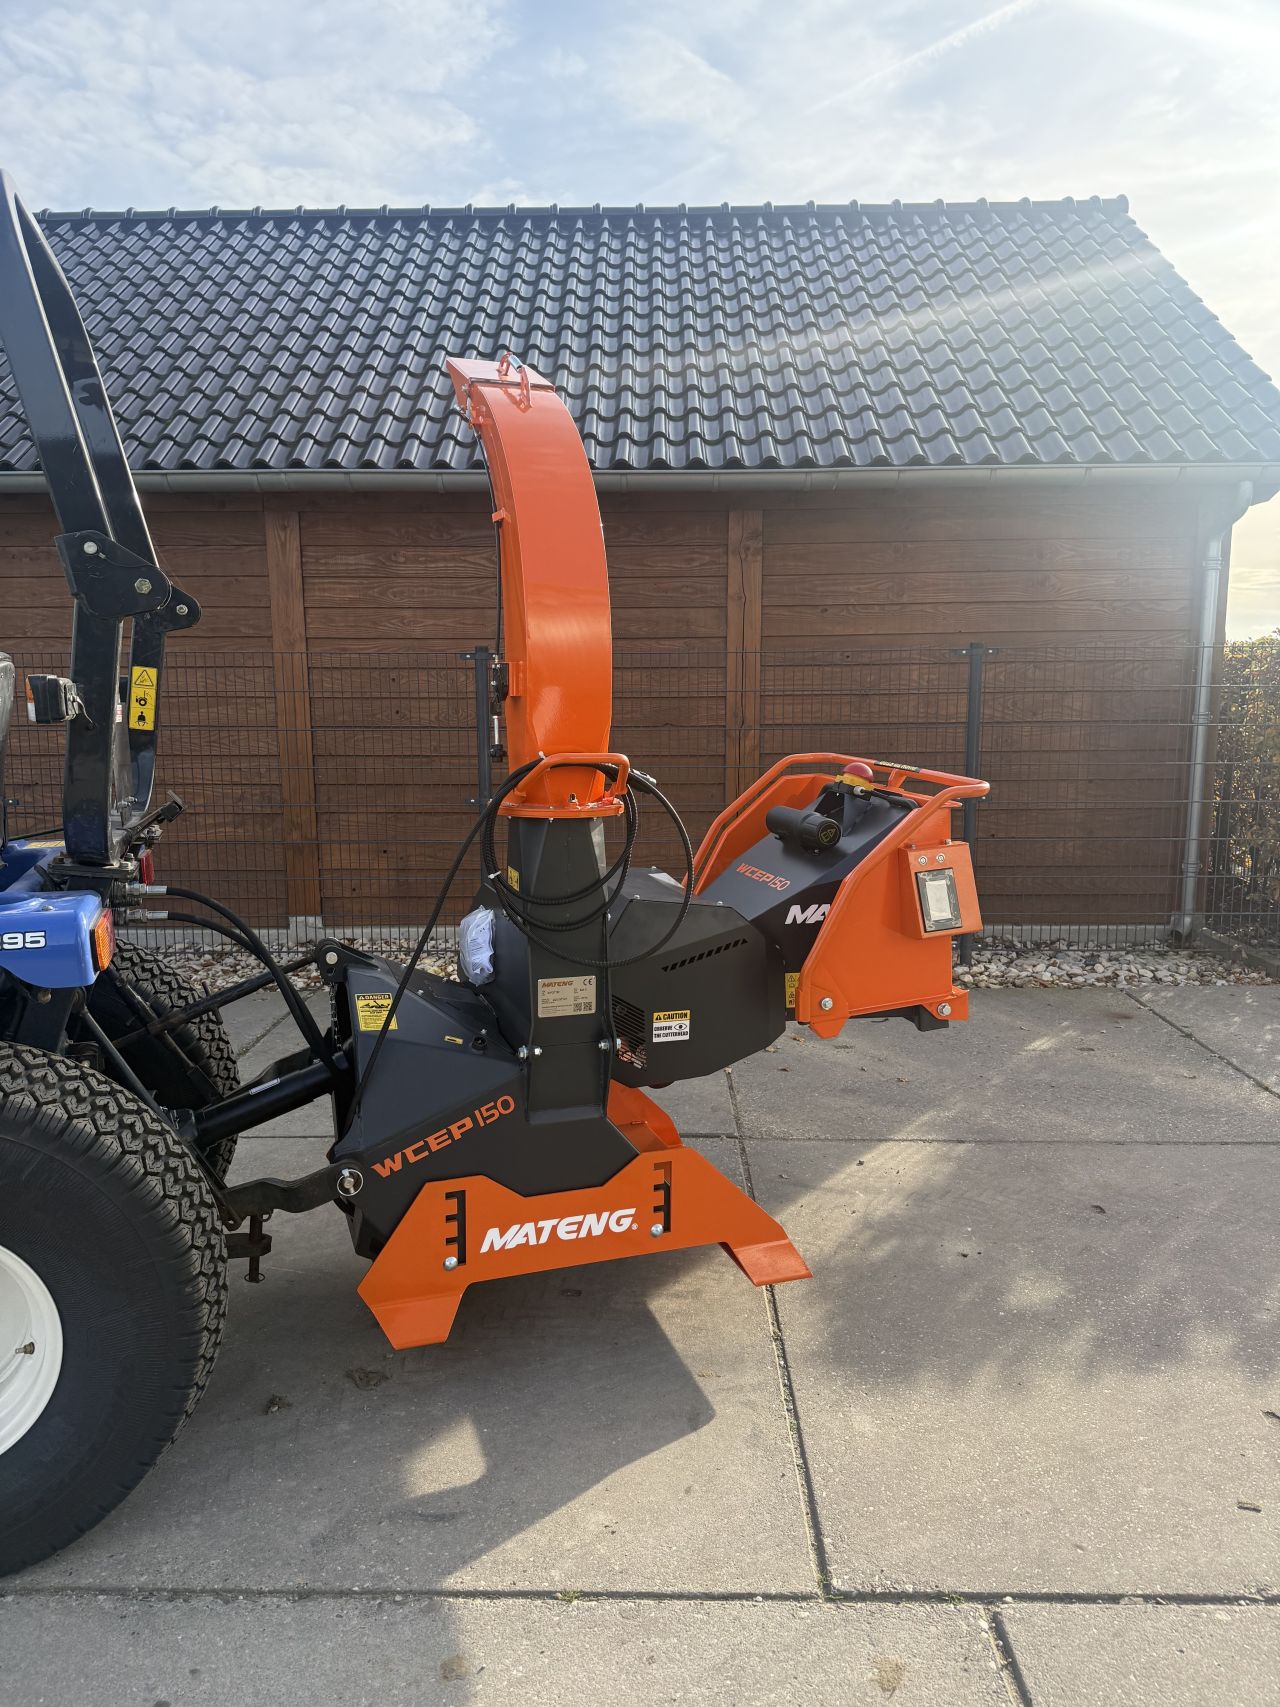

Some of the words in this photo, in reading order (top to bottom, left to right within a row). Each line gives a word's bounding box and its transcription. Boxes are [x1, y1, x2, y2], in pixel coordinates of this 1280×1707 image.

[0, 931, 46, 950] 95
[541, 980, 573, 988] MATENG
[662, 1012, 688, 1021] CAUTION
